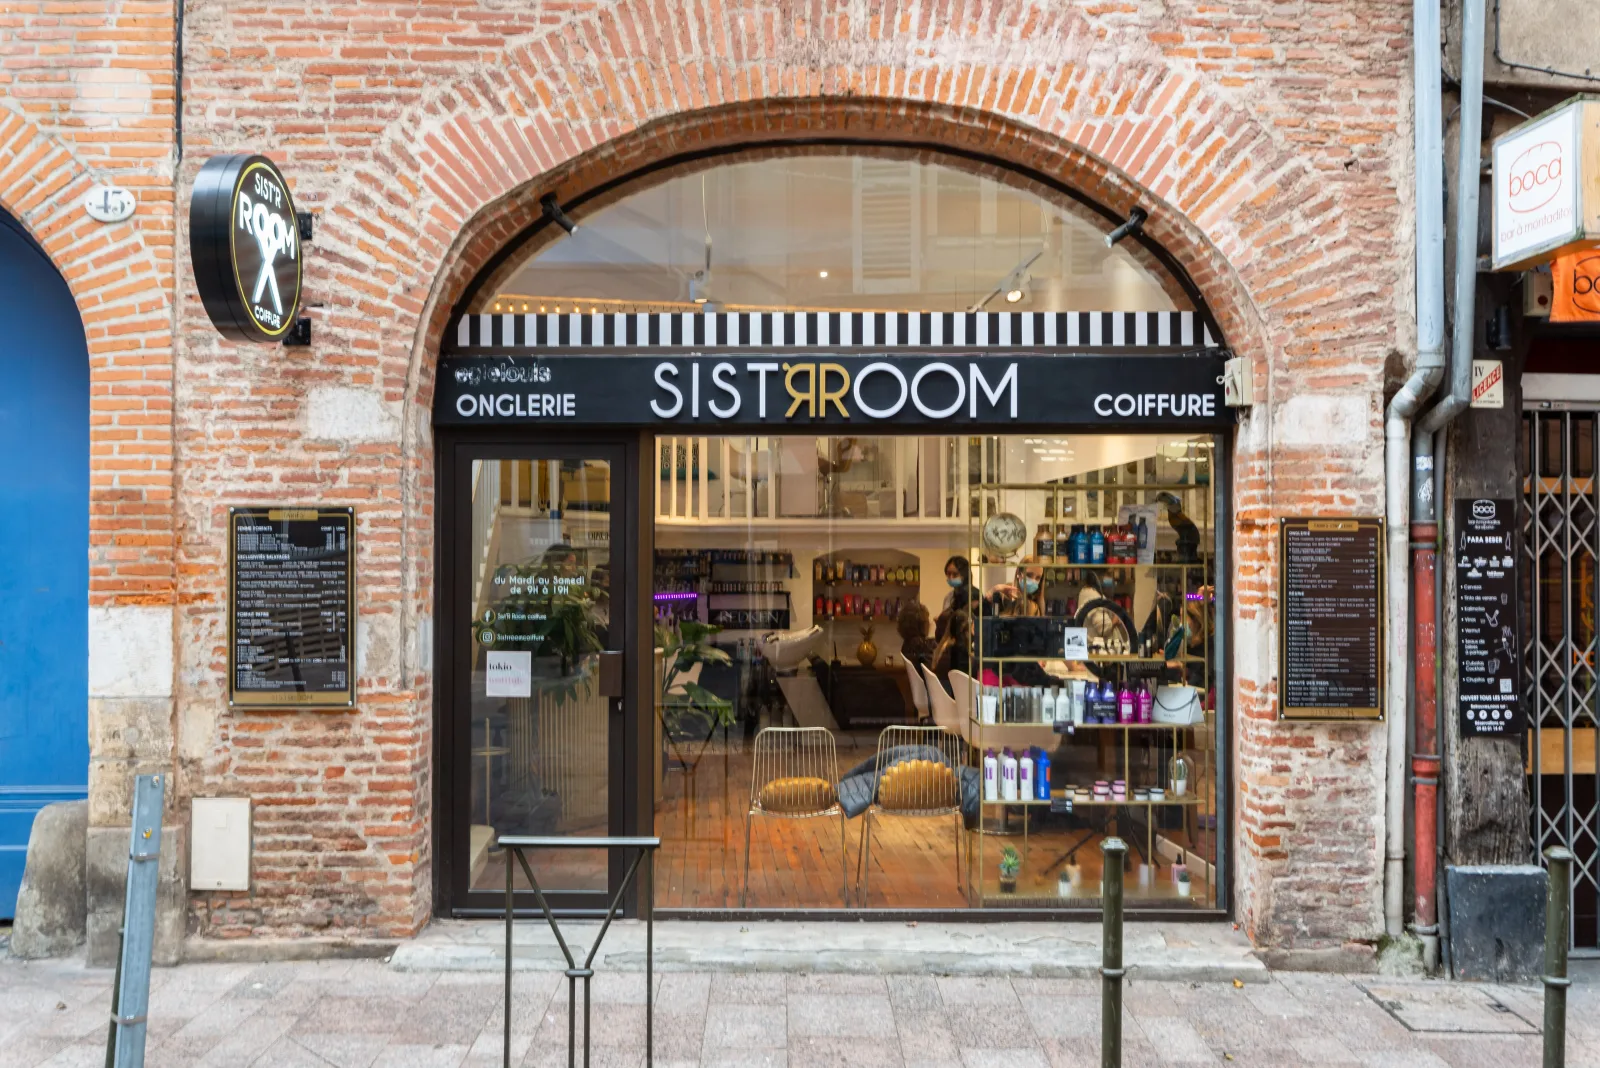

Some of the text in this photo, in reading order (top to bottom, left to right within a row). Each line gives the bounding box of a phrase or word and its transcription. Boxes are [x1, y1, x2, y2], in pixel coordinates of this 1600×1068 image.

[1508, 157, 1562, 198] boca
[96, 189, 126, 215] 45
[254, 172, 281, 208] SIST'R
[239, 191, 295, 260] ROOM
[1500, 226, 1515, 243] bar
[254, 305, 281, 329] COIFFURE
[1472, 364, 1501, 402] LICENCE
[1474, 365, 1484, 377] IV
[456, 394, 576, 417] ONGLERIE
[1094, 393, 1215, 417] COIFFURE
[1467, 535, 1503, 544] PARA BEBER
[494, 576, 585, 585] du Mardi au Samedi
[510, 585, 569, 594] de 9H à 19H
